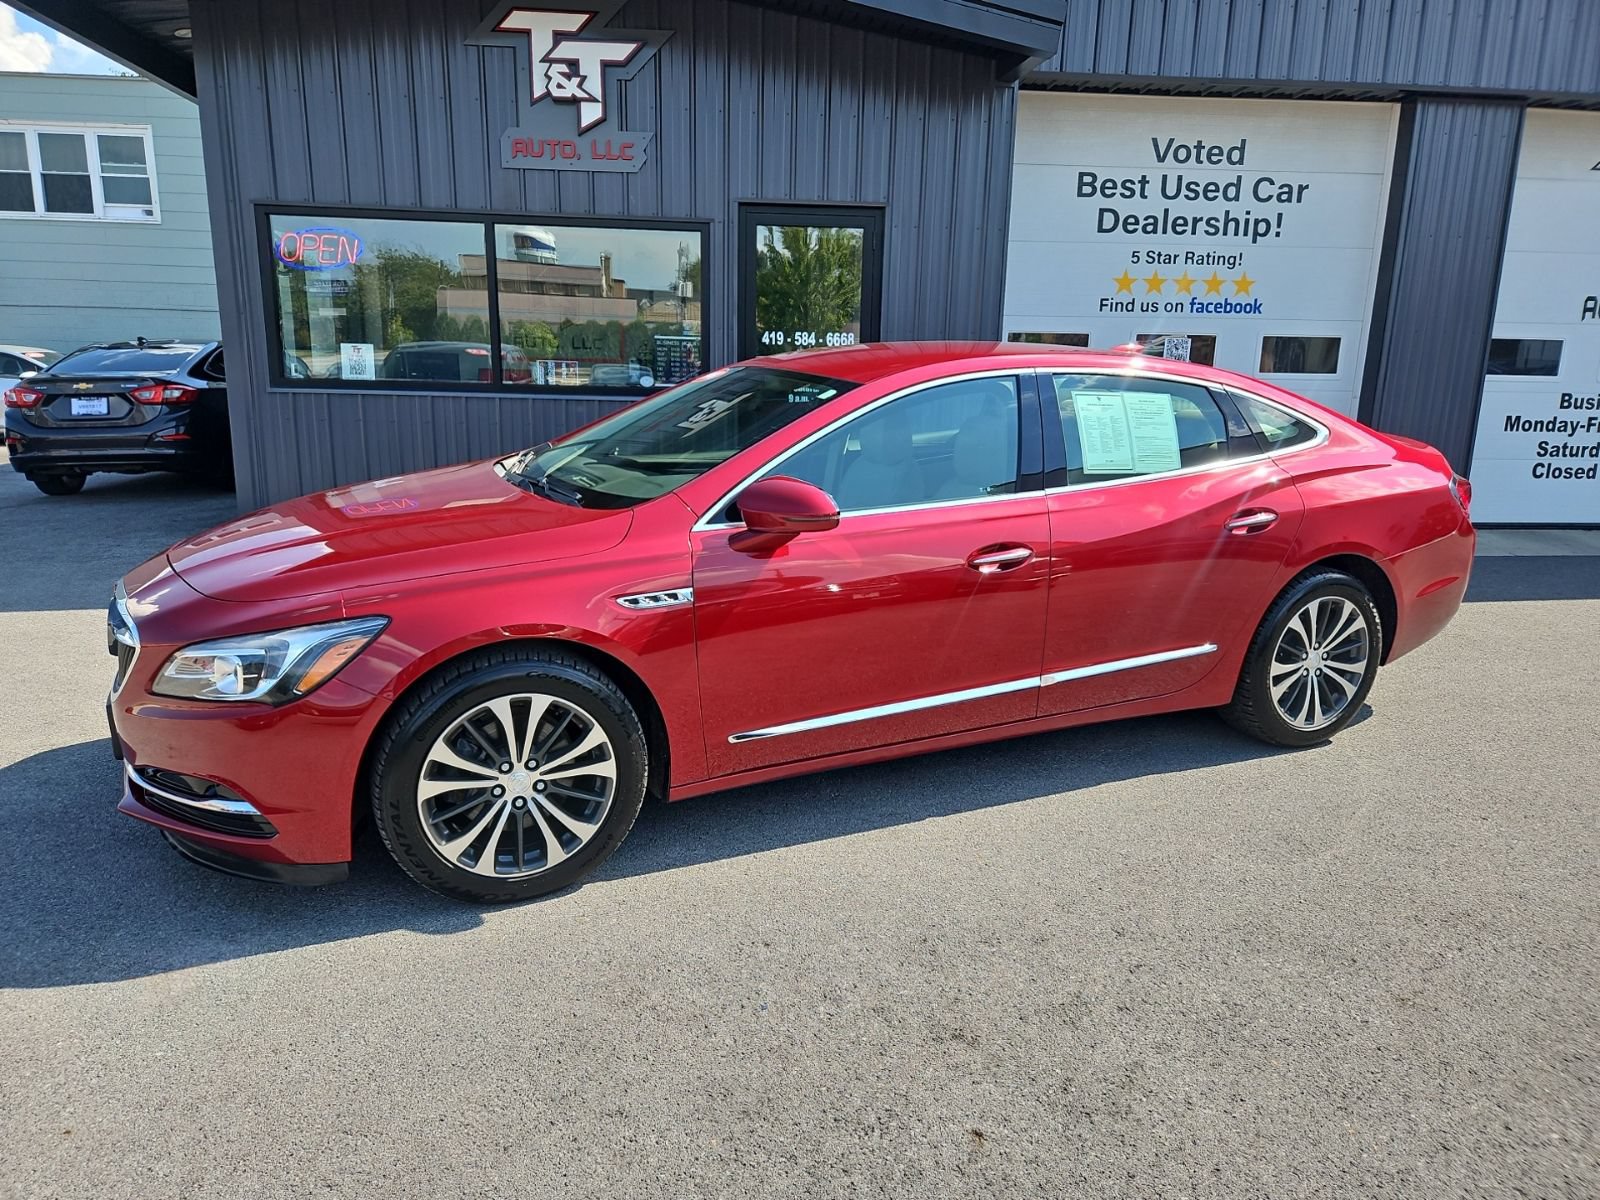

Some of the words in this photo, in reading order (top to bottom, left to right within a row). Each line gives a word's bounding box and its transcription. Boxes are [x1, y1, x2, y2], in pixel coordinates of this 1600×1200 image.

[495, 9, 643, 132] T&T
[511, 138, 581, 160] AUTO,
[591, 141, 635, 160] LLC
[1151, 137, 1247, 166] Voted
[1076, 171, 1150, 200] Best
[1160, 174, 1243, 203] Used
[1252, 177, 1310, 204] Car
[1096, 208, 1284, 245] Dealership!
[279, 231, 359, 264] OPEN
[1130, 250, 1141, 265] 5
[1145, 250, 1180, 265] Star
[1184, 251, 1243, 270] Rating!
[1098, 298, 1135, 313] Find
[1140, 302, 1160, 313] us
[1164, 302, 1184, 313] on
[1189, 297, 1263, 315] facebook
[761, 331, 784, 345] 419
[794, 332, 816, 346] 584
[826, 332, 855, 347] 6668
[788, 393, 794, 403] 9
[1536, 440, 1600, 459] Saturd
[1531, 462, 1599, 480] Closed
